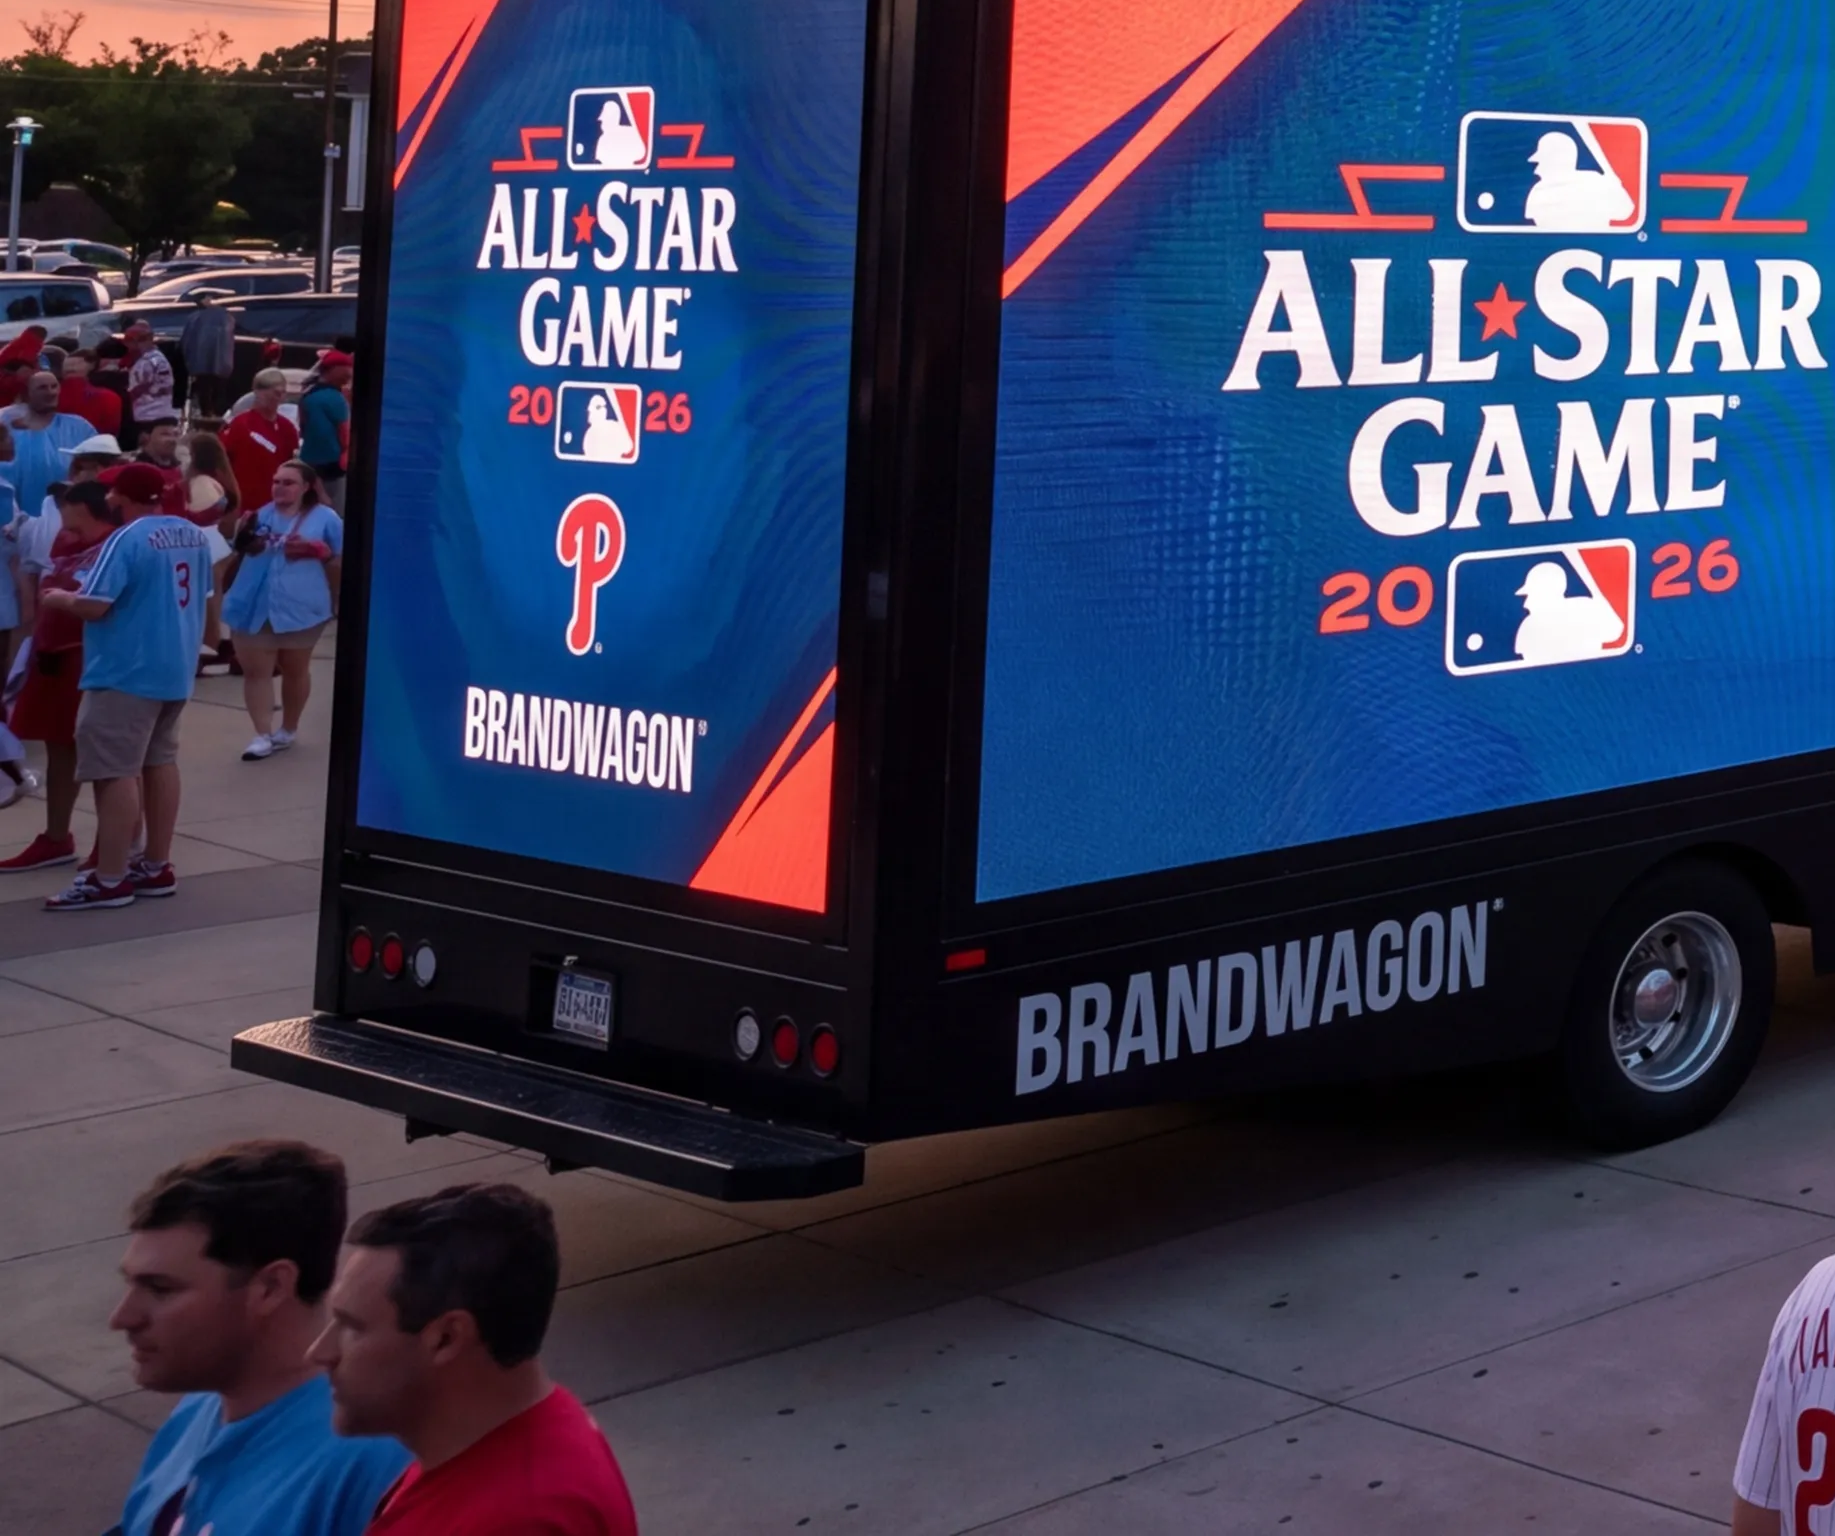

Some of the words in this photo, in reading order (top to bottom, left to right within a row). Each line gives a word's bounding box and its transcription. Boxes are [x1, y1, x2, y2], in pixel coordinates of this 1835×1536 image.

[476, 183, 579, 269] ALL
[593, 181, 738, 272] STAR
[519, 277, 684, 371] GAME
[1221, 250, 1499, 391] ALL
[1533, 249, 1828, 382] STAR
[508, 384, 554, 425] 20
[644, 391, 691, 434] 26
[1347, 394, 1728, 536] GAME
[556, 492, 626, 656] P
[1319, 565, 1434, 634] 20
[1651, 539, 1739, 599] 26
[464, 686, 695, 793] BRANDWAGON
[1015, 899, 1489, 1096] BRANDWAGON
